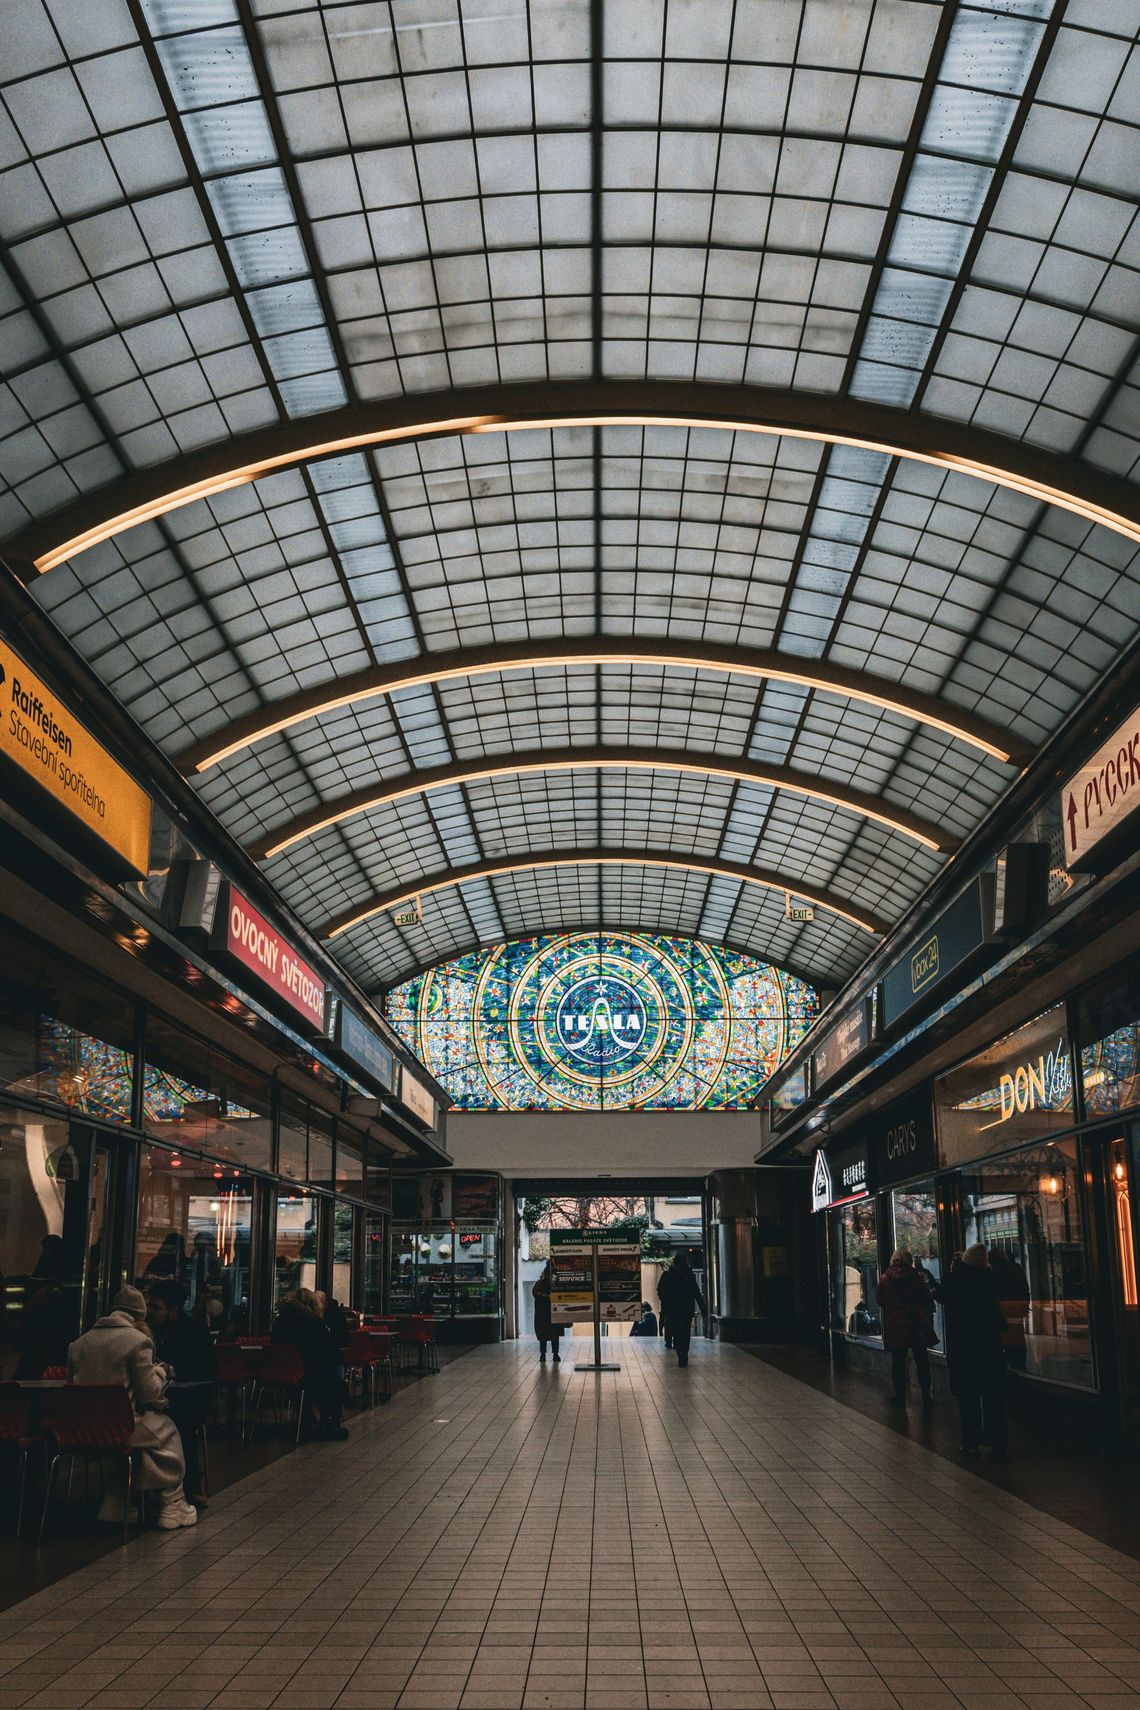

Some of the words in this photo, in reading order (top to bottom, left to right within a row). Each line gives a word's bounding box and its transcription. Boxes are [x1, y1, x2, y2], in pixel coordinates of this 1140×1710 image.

[11, 677, 73, 757] Raiffeisen
[9, 709, 58, 772] Stavební
[59, 761, 106, 818] spořitelna
[400, 913, 415, 923] EXIT
[793, 909, 808, 920] EXIT
[231, 905, 279, 974] OVOCNÝ
[562, 1013, 641, 1031] TESLA
[580, 1042, 621, 1057] Radio
[1000, 1055, 1048, 1121] DON
[887, 1120, 916, 1160] CARYS
[461, 1234, 481, 1243] OPEN
